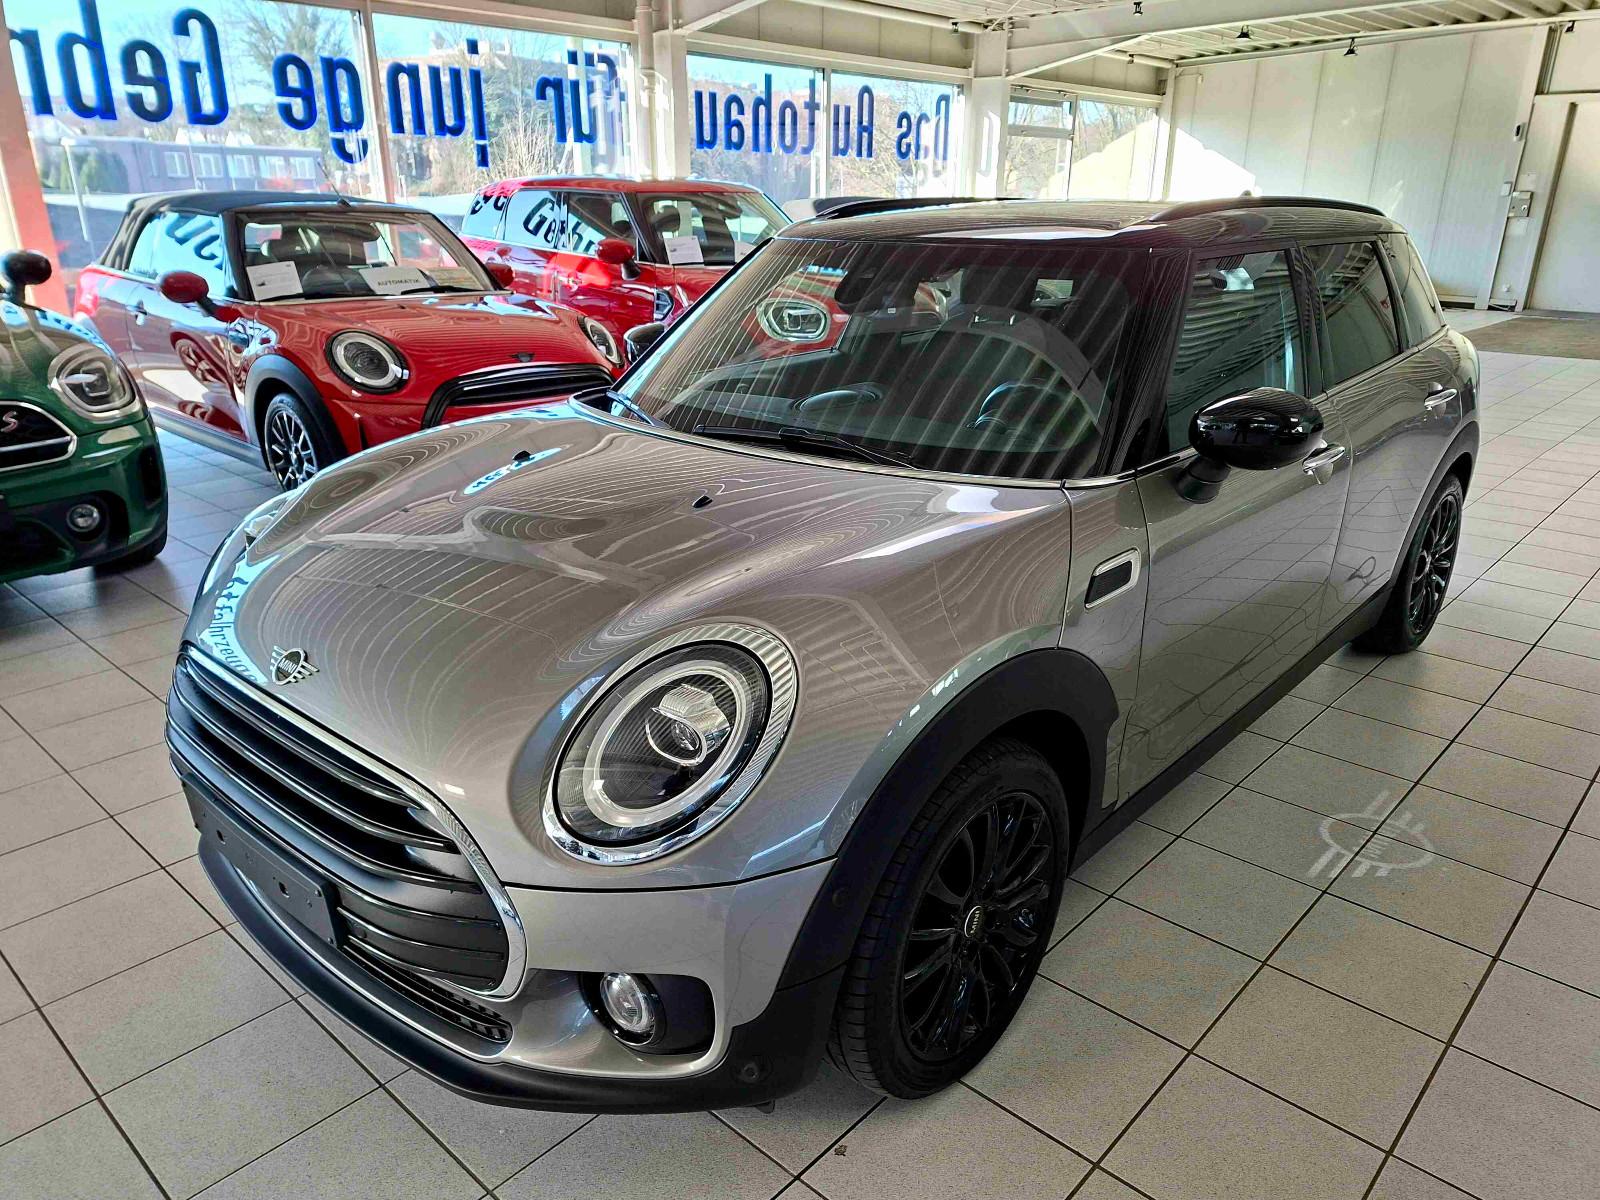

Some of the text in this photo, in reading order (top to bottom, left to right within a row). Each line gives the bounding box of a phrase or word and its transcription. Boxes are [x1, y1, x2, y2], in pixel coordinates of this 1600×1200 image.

[0, 410, 18, 433] S
[278, 657, 299, 675] MINI
[970, 910, 980, 934] MINI
